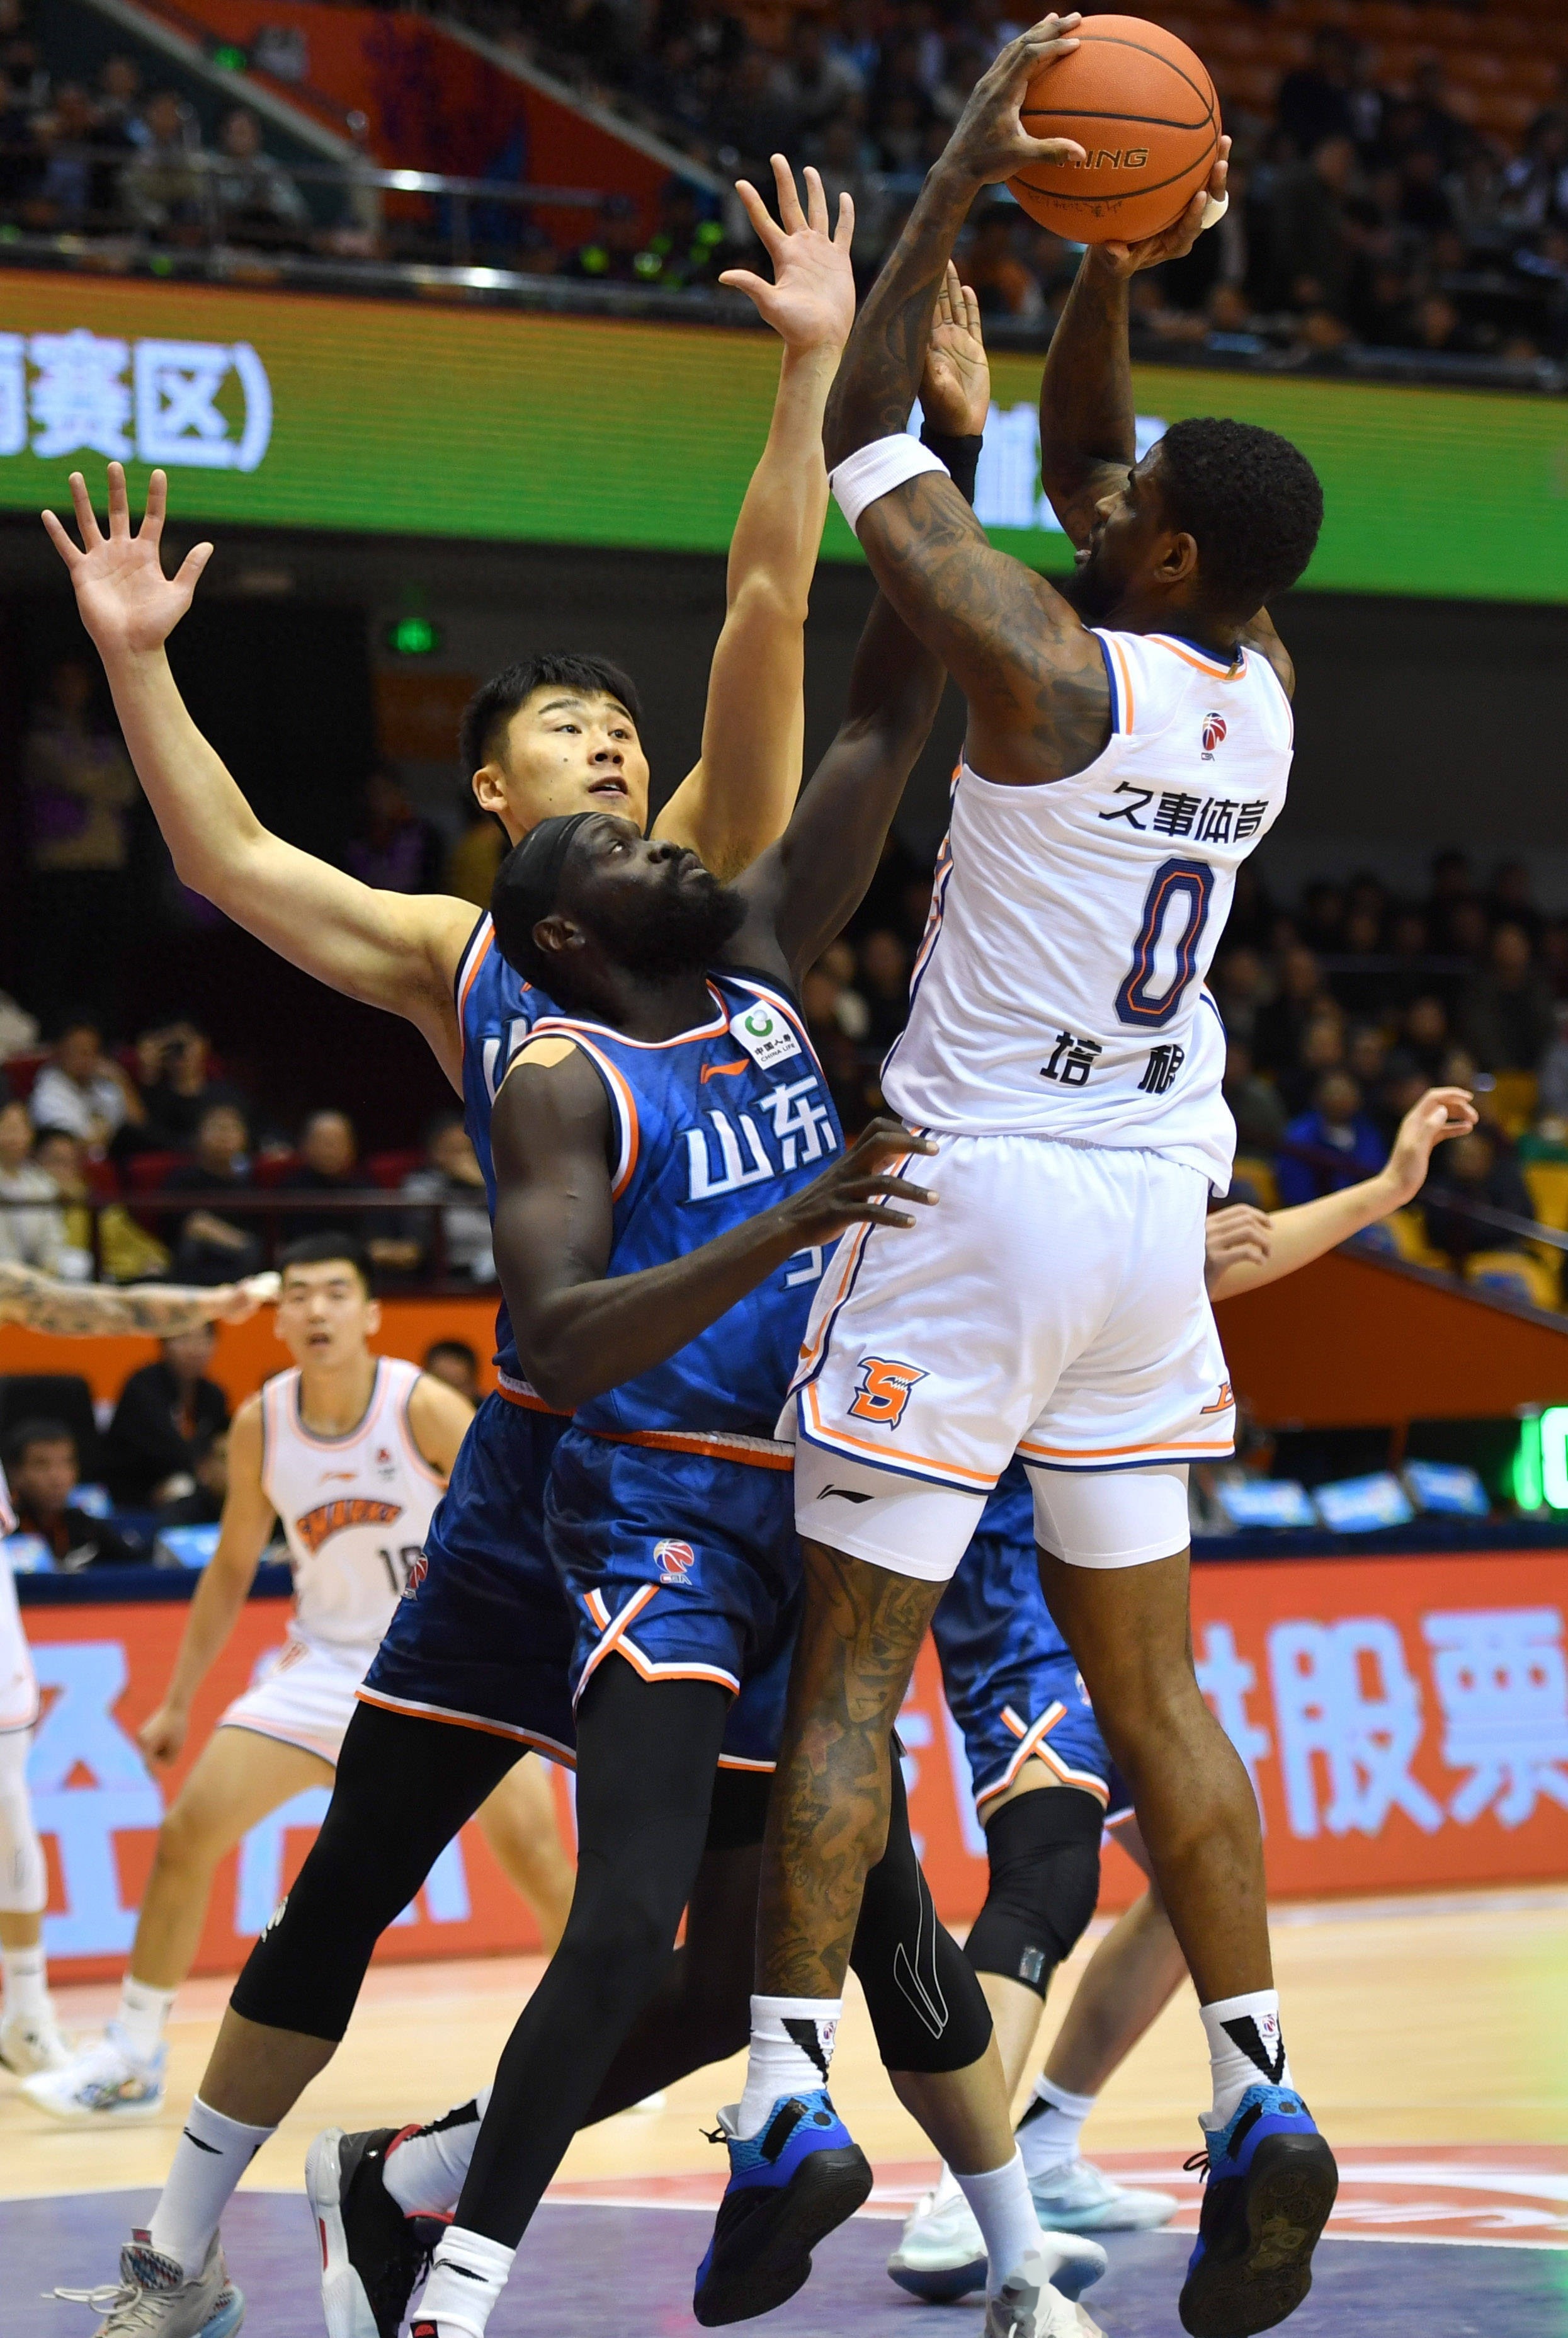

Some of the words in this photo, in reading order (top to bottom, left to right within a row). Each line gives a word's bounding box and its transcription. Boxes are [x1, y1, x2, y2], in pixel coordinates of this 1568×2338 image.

[1058, 147, 1149, 170] ING
[0, 328, 273, 472] 赛区)
[1098, 780, 1270, 844] 久事体育
[1113, 855, 1216, 1029] 0
[761, 1049, 781, 1062] CHINA
[681, 1075, 838, 1202] 山东
